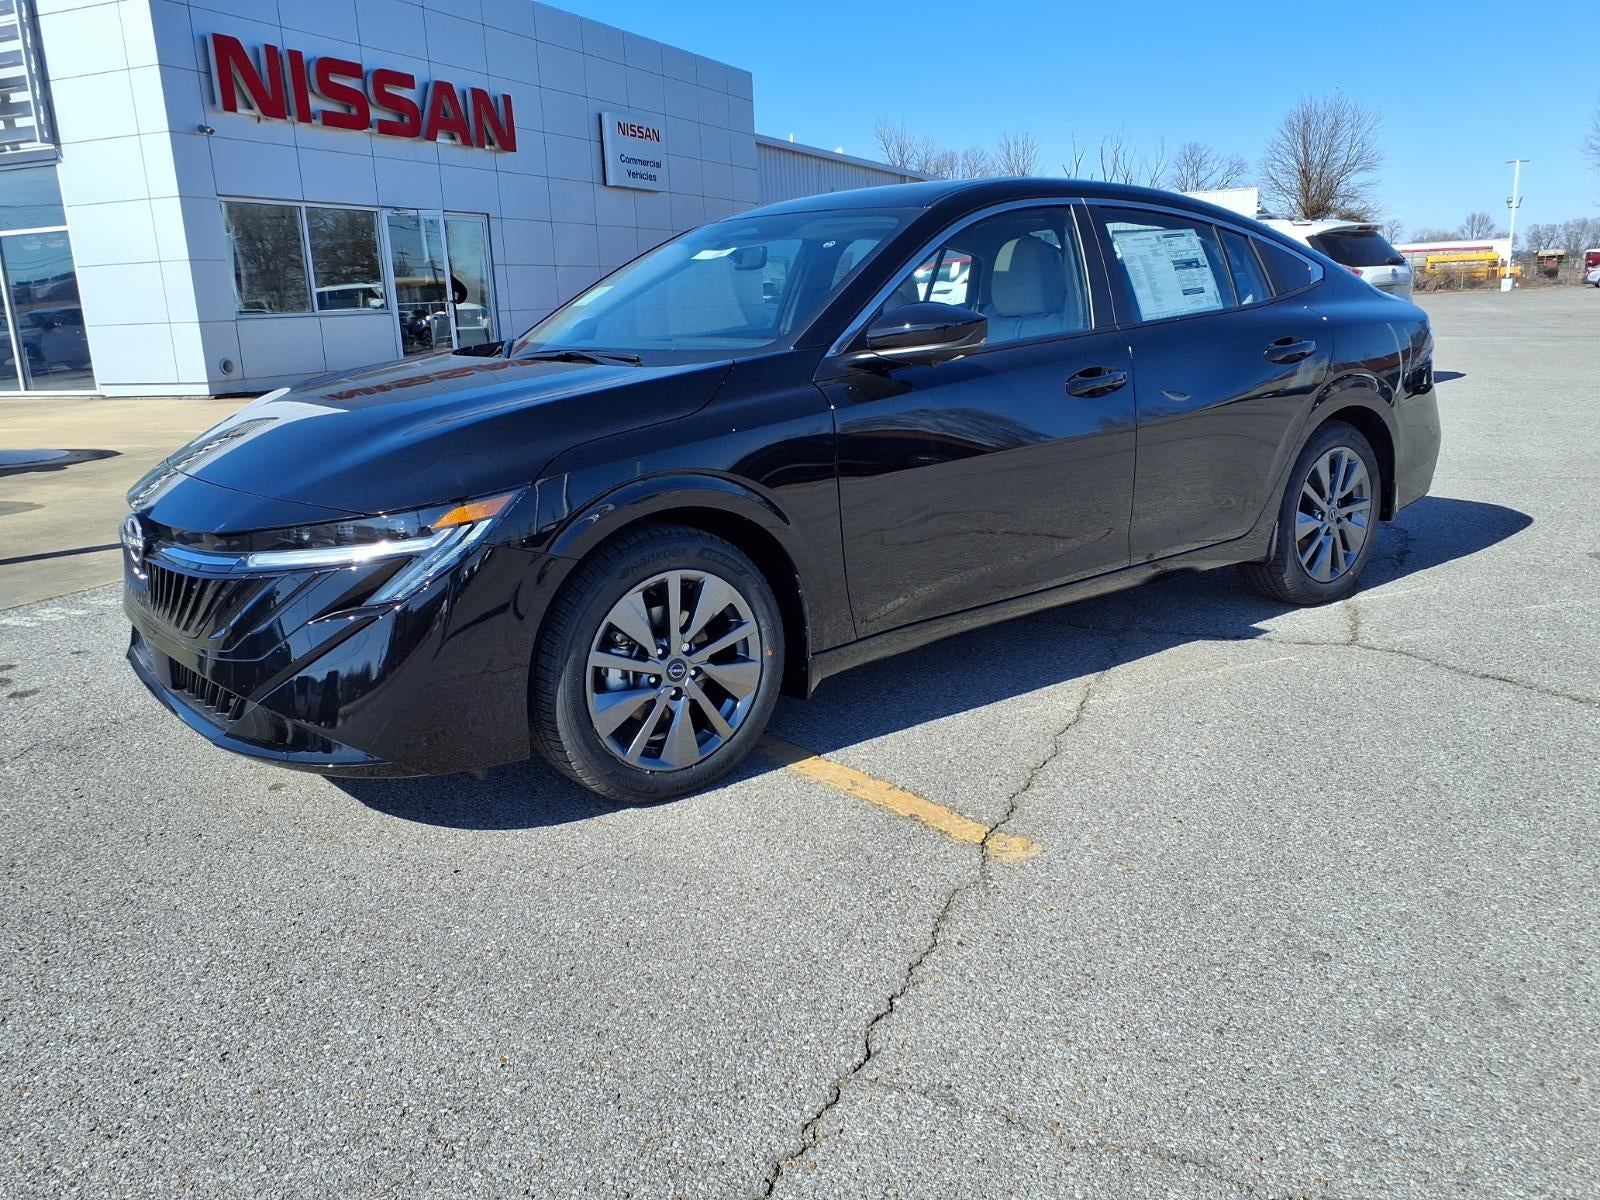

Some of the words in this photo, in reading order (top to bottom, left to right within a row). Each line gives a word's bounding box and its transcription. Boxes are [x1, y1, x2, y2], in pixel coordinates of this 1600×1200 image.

[210, 32, 517, 153] NISSAN
[617, 121, 660, 142] NISSAN
[619, 153, 662, 169] Commercial
[626, 169, 657, 182] Vehicles
